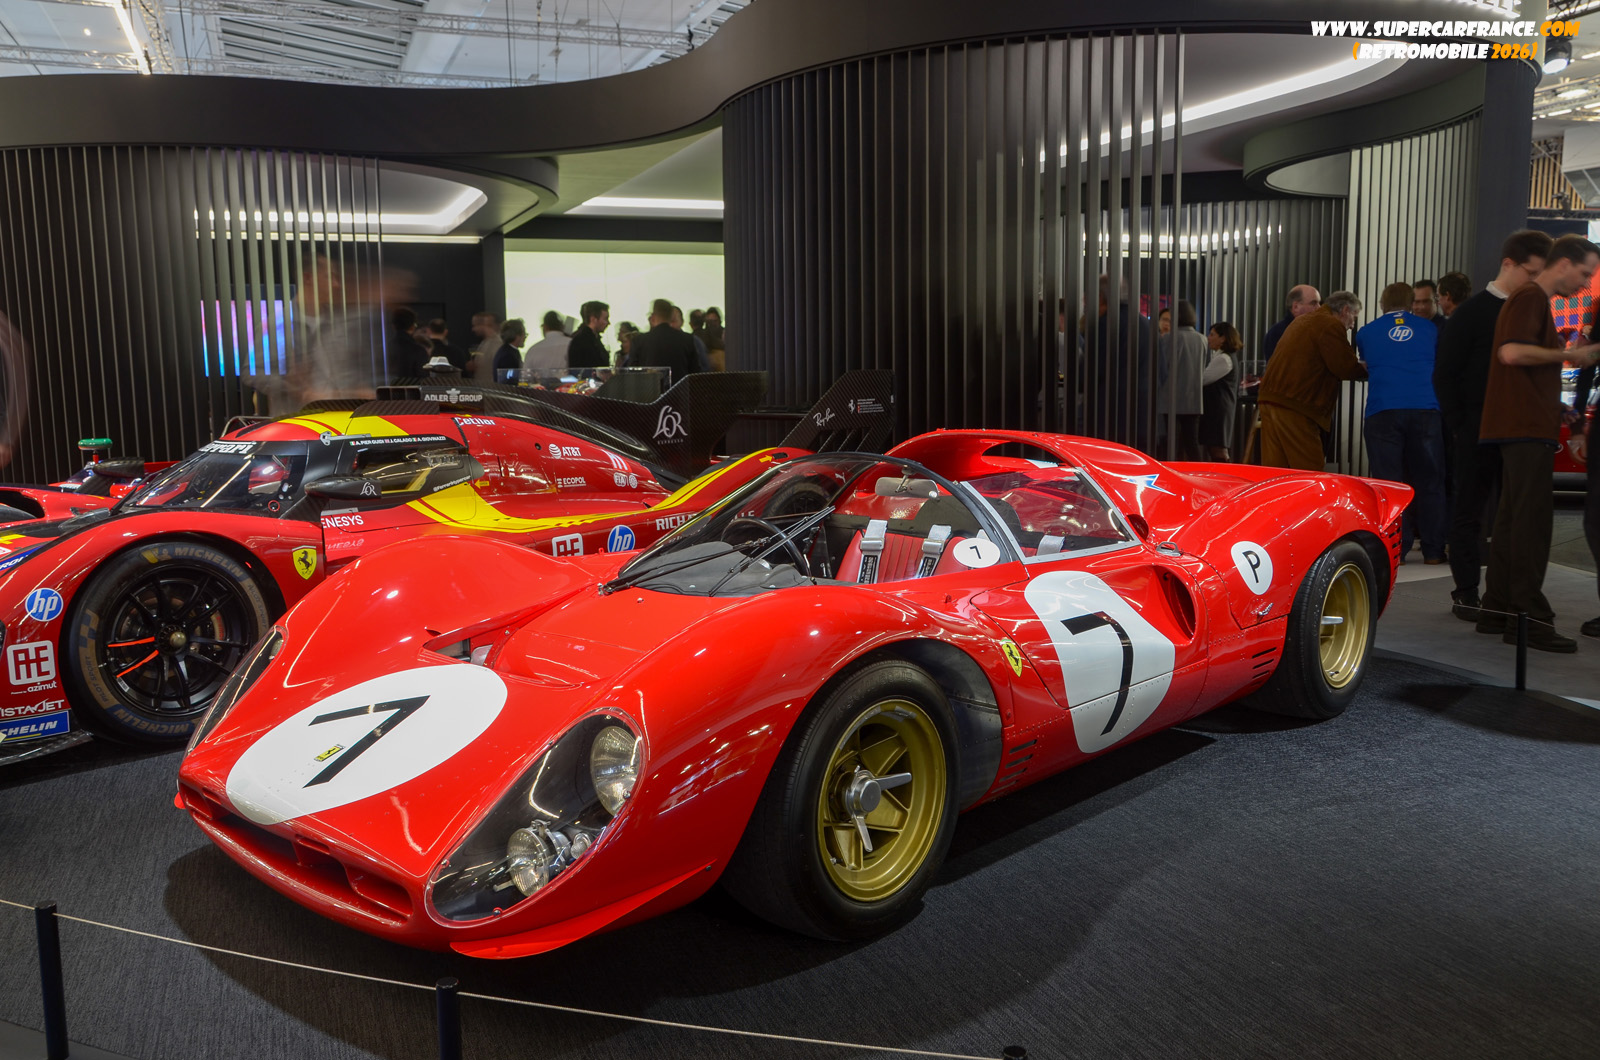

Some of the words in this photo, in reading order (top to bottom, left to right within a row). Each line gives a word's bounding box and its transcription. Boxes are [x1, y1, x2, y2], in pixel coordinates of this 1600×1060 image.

[1392, 326, 1410, 341] hp
[424, 394, 448, 402] ADLER
[459, 394, 483, 402] GROUP
[562, 446, 582, 457] AT&T
[563, 476, 586, 485] ECOPOL
[320, 514, 364, 529] ENESYS
[613, 527, 633, 552] hp
[969, 545, 982, 560] 7
[174, 547, 244, 578] MICHELIN
[1242, 550, 1261, 584] P
[32, 589, 59, 621] hp
[1060, 610, 1134, 737] 7
[27, 681, 57, 693] azimut
[0, 698, 65, 717] ISTAJET
[113, 708, 189, 734] MICHELIN
[302, 695, 431, 788] 7
